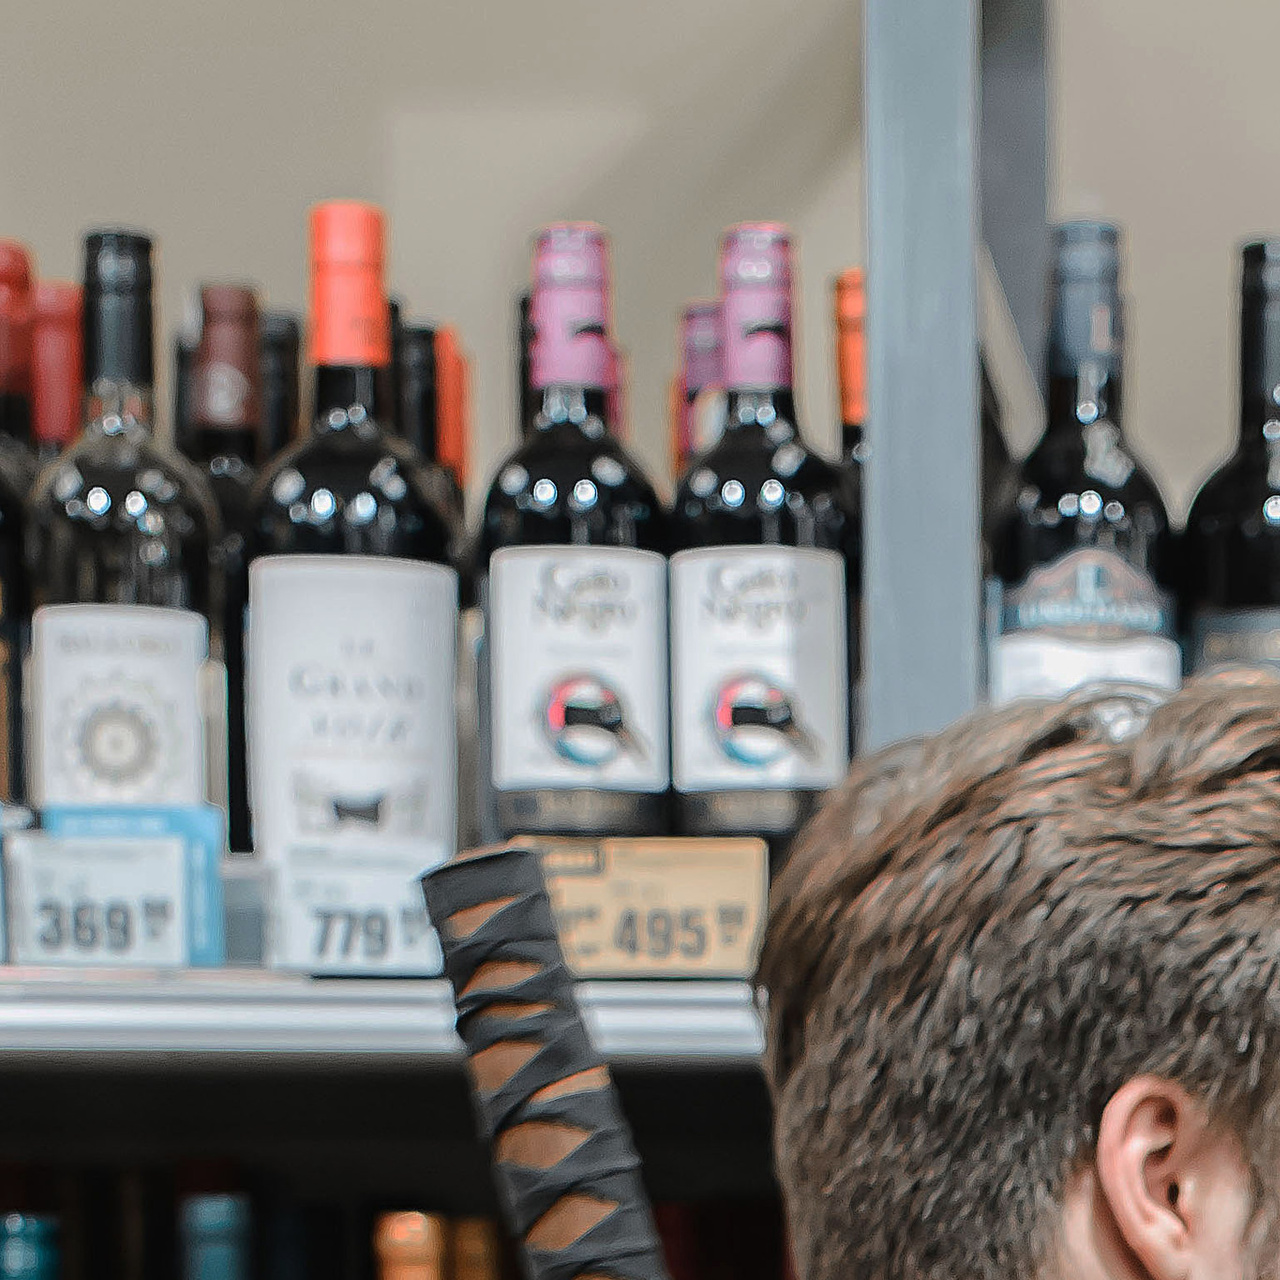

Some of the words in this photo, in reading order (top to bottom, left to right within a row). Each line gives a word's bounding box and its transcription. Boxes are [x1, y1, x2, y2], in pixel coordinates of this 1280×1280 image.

[38, 901, 132, 949] 369
[313, 904, 392, 956] 779
[613, 907, 708, 957] 495
